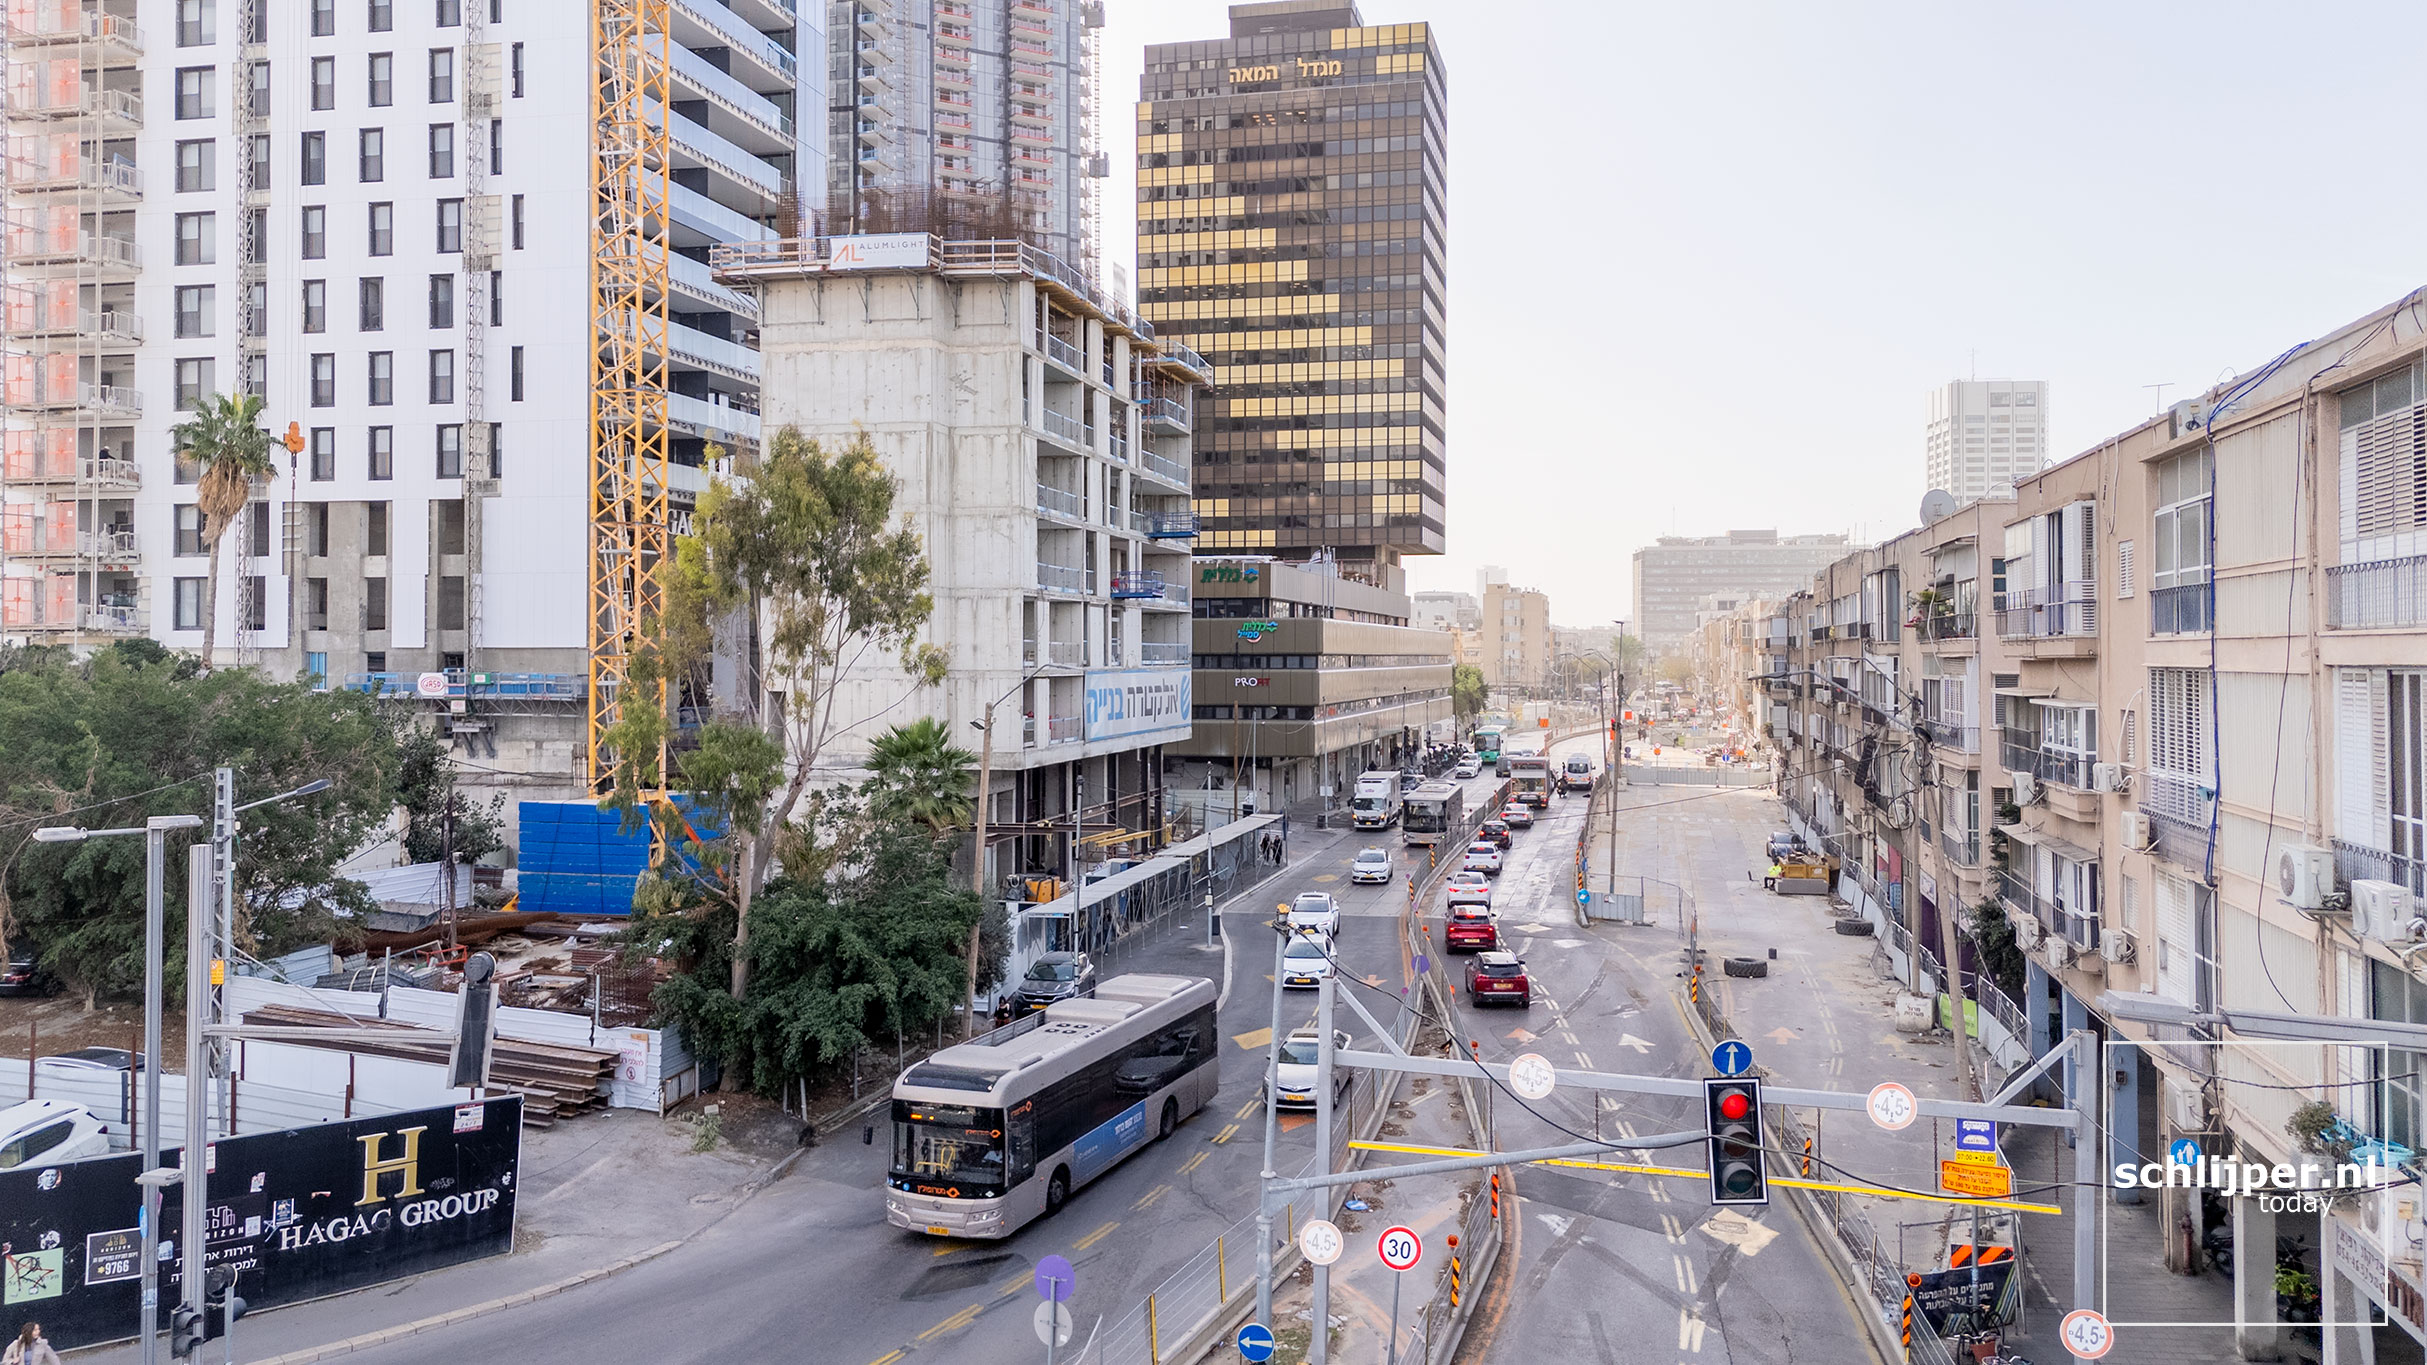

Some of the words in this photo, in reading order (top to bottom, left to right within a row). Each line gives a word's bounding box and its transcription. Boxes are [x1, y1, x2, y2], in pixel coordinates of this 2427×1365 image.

[1229, 65, 1279, 83] המאה
[1297, 57, 1342, 77] מגדל
[859, 241, 924, 250] ALUMLIGHT
[1200, 566, 1240, 583] כללית
[1237, 629, 1260, 639] סמייל
[1241, 622, 1267, 632] כללית
[1086, 687, 1124, 723] בנייה
[1127, 678, 1178, 722] אלקטרה
[354, 1125, 428, 1206] H
[400, 1188, 499, 1227] GROUP
[205, 1226, 244, 1240] RIZON
[1311, 1233, 1331, 1251] 4.5
[1387, 1239, 1411, 1259] 30
[1960, 1282, 1994, 1294] מתנלים
[2074, 1323, 2099, 1345] 4.5
